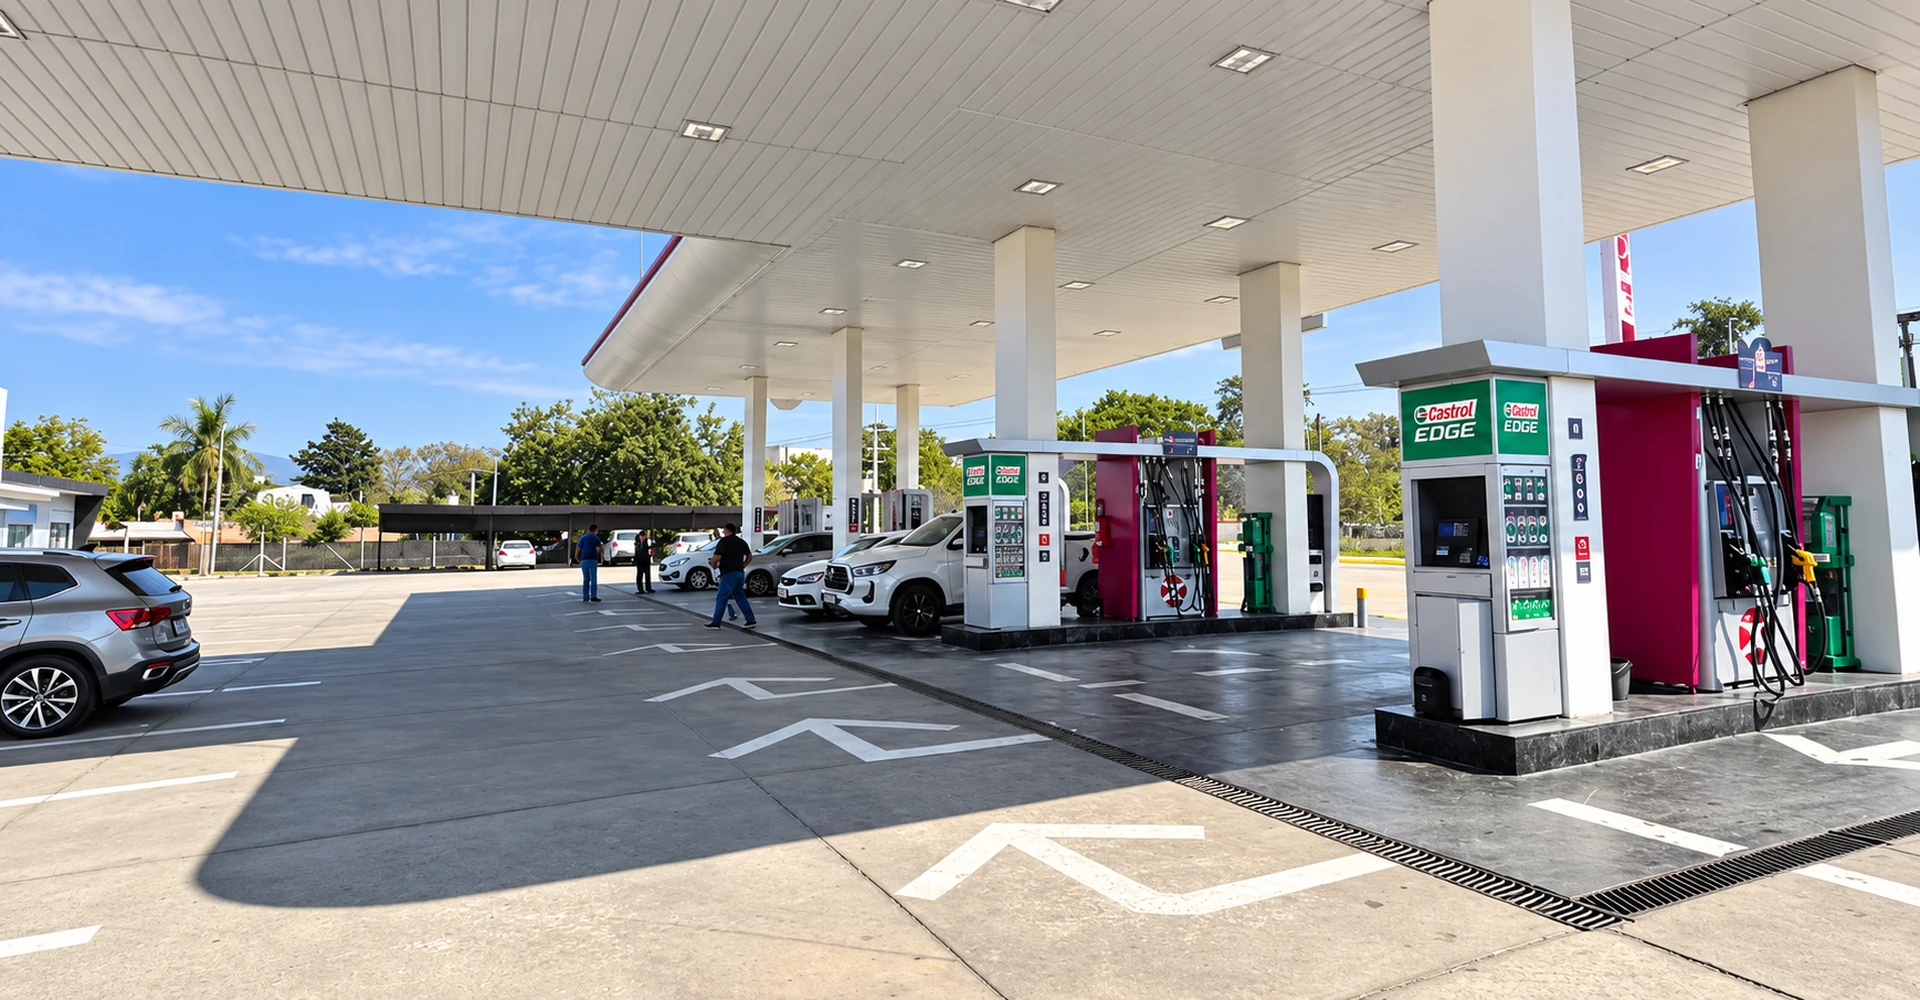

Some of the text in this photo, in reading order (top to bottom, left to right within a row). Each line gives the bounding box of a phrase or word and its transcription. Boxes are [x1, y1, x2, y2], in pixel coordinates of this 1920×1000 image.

[1429, 401, 1474, 421] Castrol
[1414, 422, 1477, 442] EDGE
[1504, 420, 1538, 433] EDGE
